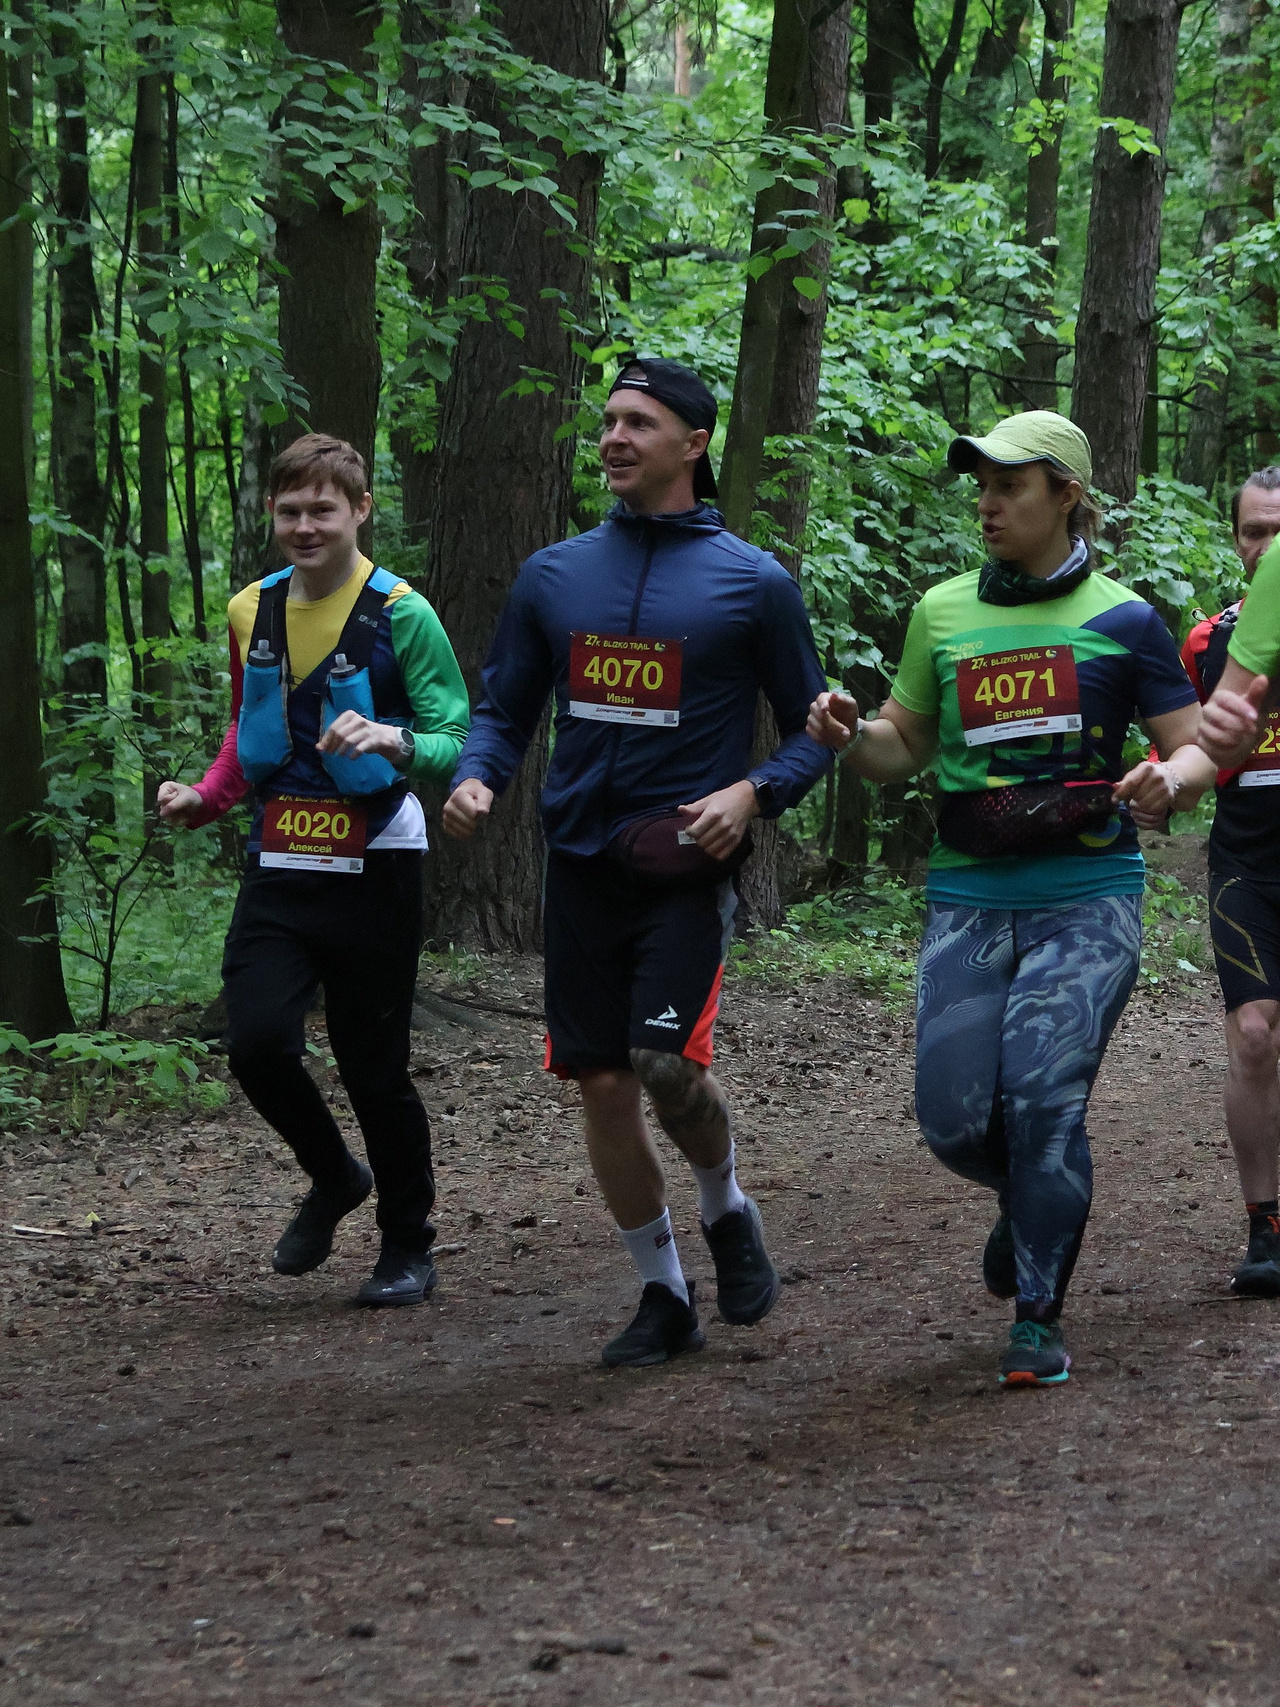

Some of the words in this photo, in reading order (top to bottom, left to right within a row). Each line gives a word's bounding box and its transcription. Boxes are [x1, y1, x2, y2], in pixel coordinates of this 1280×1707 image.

[603, 640, 629, 650] BLIZKO
[630, 642, 651, 651] TRAIL
[991, 655, 1018, 666] BLIZKO
[1019, 652, 1042, 662] TRAIL
[584, 656, 664, 690] 4070
[975, 668, 1056, 706] 4071
[606, 693, 635, 704] Иван
[995, 707, 1044, 721] Евгения
[276, 809, 351, 840] 4020
[288, 842, 332, 853] Алексей
[645, 1018, 681, 1030] DEMIX
